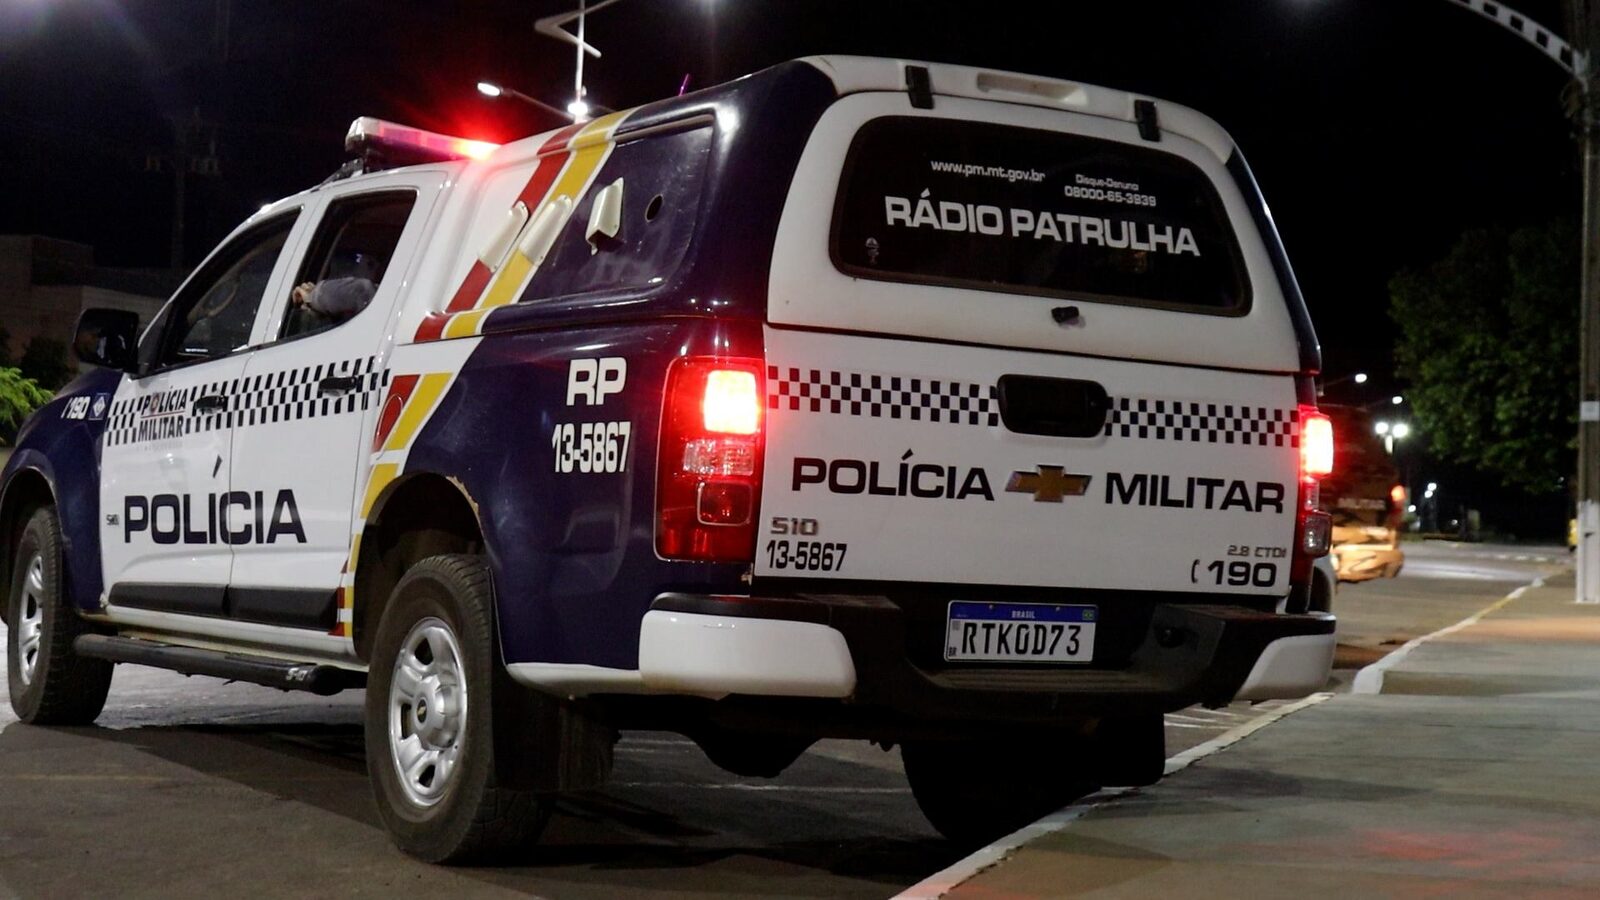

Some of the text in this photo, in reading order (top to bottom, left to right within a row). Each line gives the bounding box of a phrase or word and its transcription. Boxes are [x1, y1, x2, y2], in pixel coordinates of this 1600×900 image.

[930, 160, 1046, 182] www.pm.mt.gov.br
[884, 187, 1201, 257] RÁDIO PATRULHA
[566, 357, 627, 406] RP
[141, 385, 188, 416] POLÍCIA
[138, 415, 184, 442] MILITAR
[551, 421, 631, 473] 13-5867
[791, 448, 1285, 513] POLÍCIA MILITAR
[124, 454, 307, 545] POLÍCIA
[770, 517, 819, 535] S10
[766, 540, 847, 571] 13-5867
[1207, 560, 1277, 588] 190
[1011, 610, 1036, 619] BRASIL
